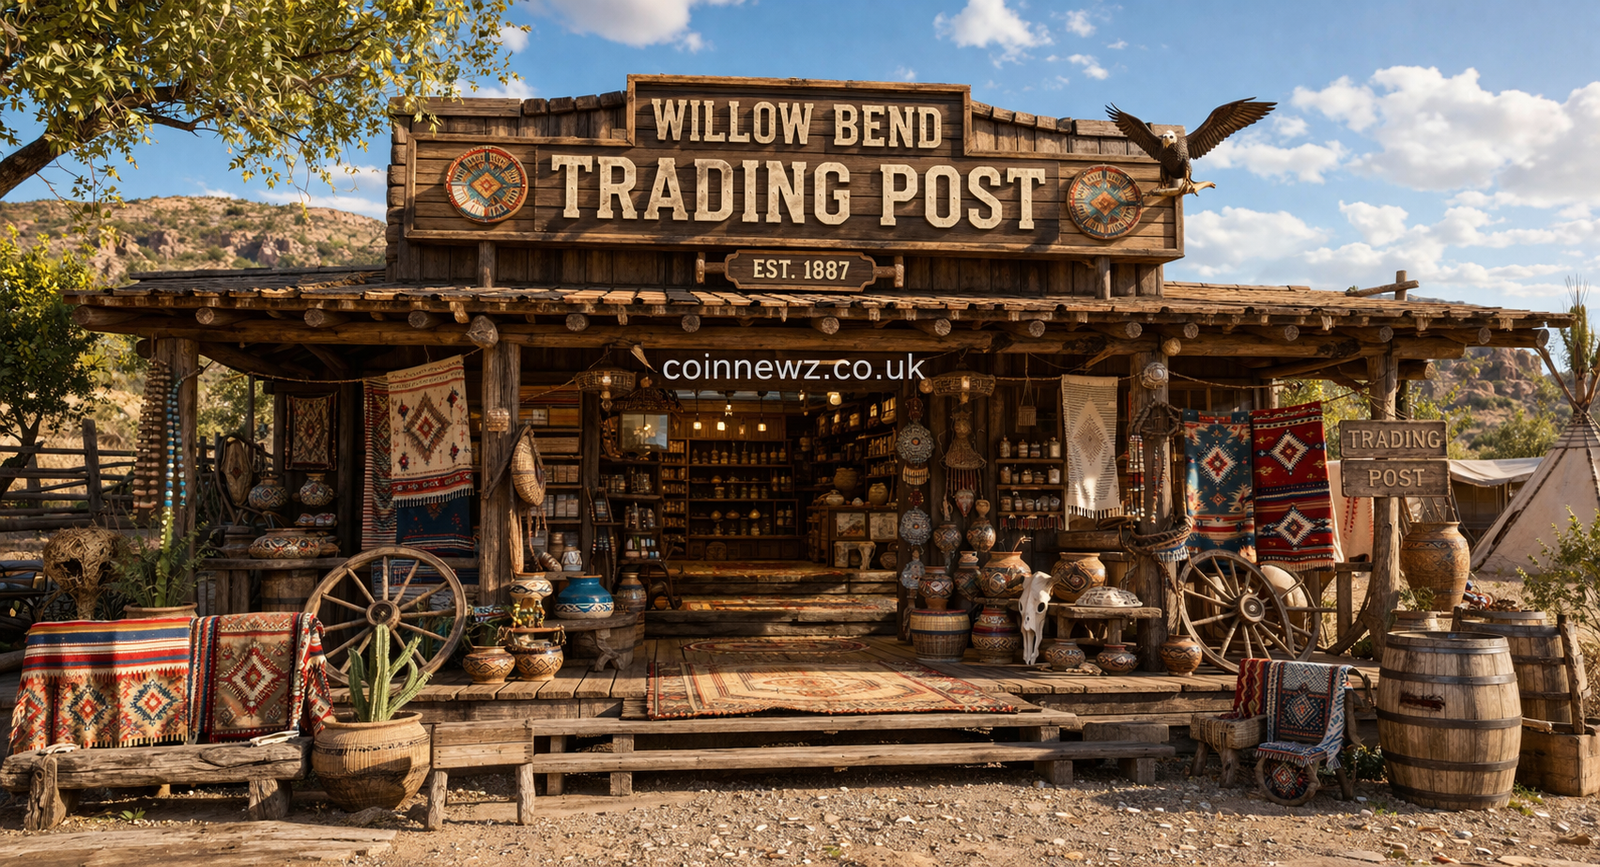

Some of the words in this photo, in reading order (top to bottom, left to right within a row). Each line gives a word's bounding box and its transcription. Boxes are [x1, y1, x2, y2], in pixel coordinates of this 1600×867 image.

[652, 98, 814, 145] WILLOW
[834, 103, 942, 149] BEND
[551, 154, 851, 225] TRADING
[880, 163, 1046, 229] POST
[753, 259, 796, 279] EST.
[804, 260, 850, 280] 1887
[1347, 429, 1441, 448] TRADING
[1368, 468, 1425, 487] POST
